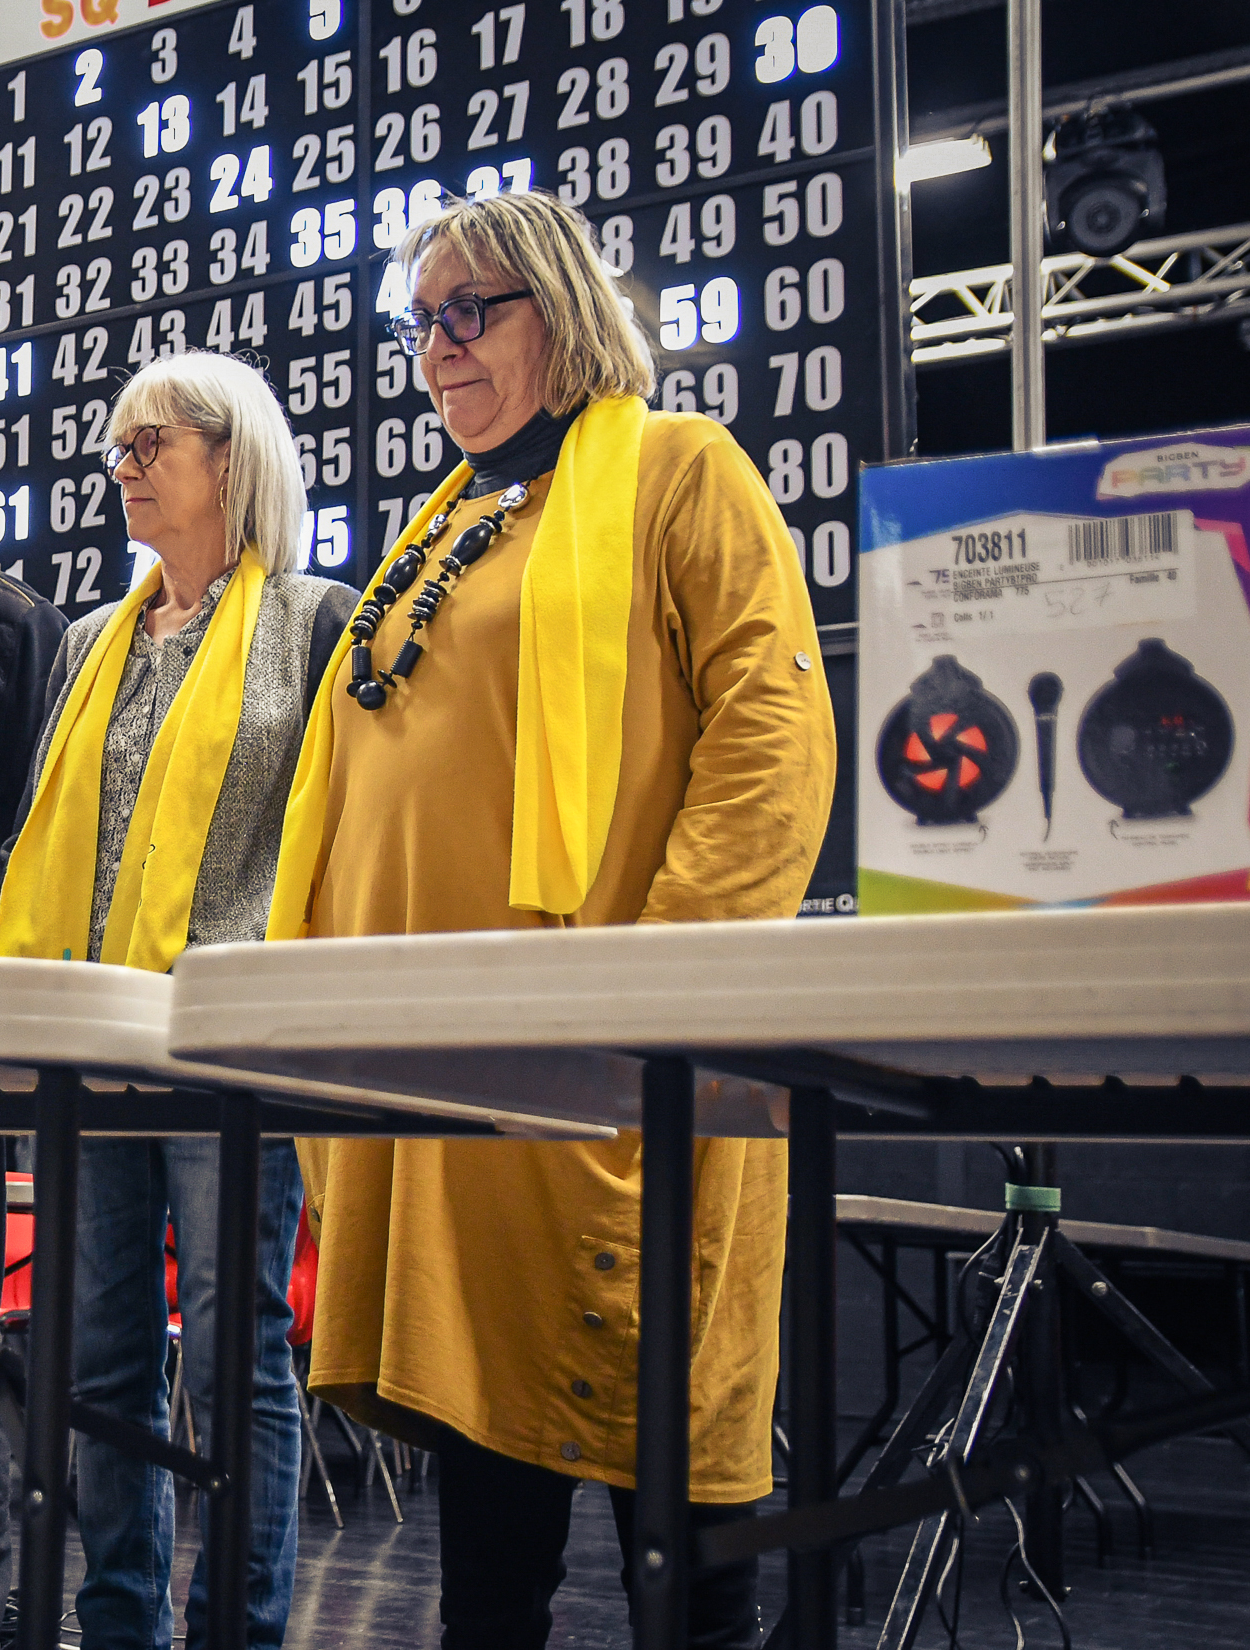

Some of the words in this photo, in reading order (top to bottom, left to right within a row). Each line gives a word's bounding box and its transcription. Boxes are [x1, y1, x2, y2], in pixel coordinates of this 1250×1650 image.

[8, 71, 25, 122] 1
[75, 49, 103, 107] 2
[151, 29, 177, 83] 3
[229, 5, 256, 59] 4
[64, 117, 112, 176] 12
[137, 95, 190, 158] 13
[216, 74, 268, 136] 14
[297, 51, 352, 115] 15
[380, 29, 437, 93] 16
[472, 4, 525, 69] 17
[58, 187, 113, 249] 22
[133, 167, 190, 231] 23
[210, 145, 272, 213] 24
[292, 124, 354, 192] 25
[375, 104, 440, 172] 26
[468, 80, 529, 150] 27
[557, 58, 629, 129] 28
[655, 34, 730, 107] 29
[755, 5, 837, 83] 30
[56, 258, 111, 318] 32
[131, 240, 188, 302] 33
[210, 220, 270, 284] 34
[290, 199, 356, 267] 35
[558, 138, 631, 208] 38
[656, 115, 731, 187] 39
[758, 91, 837, 162] 40
[52, 327, 108, 386] 42
[128, 309, 187, 366] 43
[206, 290, 268, 354] 44
[289, 272, 351, 336] 45
[375, 259, 418, 319] 4
[600, 215, 635, 274] 8
[660, 195, 735, 263] 49
[764, 173, 842, 245] 50
[51, 399, 108, 461] 52
[289, 350, 351, 414] 55
[659, 277, 740, 351] 59
[765, 259, 844, 330] 60
[51, 473, 106, 532] 62
[376, 412, 443, 478] 66
[769, 346, 841, 417] 70
[1112, 457, 1246, 489] PARTY
[1157, 452, 1199, 462] BIGBEN
[52, 547, 103, 607] 72
[127, 540, 162, 592] 7
[768, 433, 849, 505] 80
[796, 521, 851, 588] 0
[952, 528, 1027, 565] 703811
[953, 567, 991, 579] ENCEINTE
[993, 562, 1040, 576] LUMINEUSE
[953, 578, 982, 591] BIGBEN
[953, 587, 1003, 602] CONFORAMA
